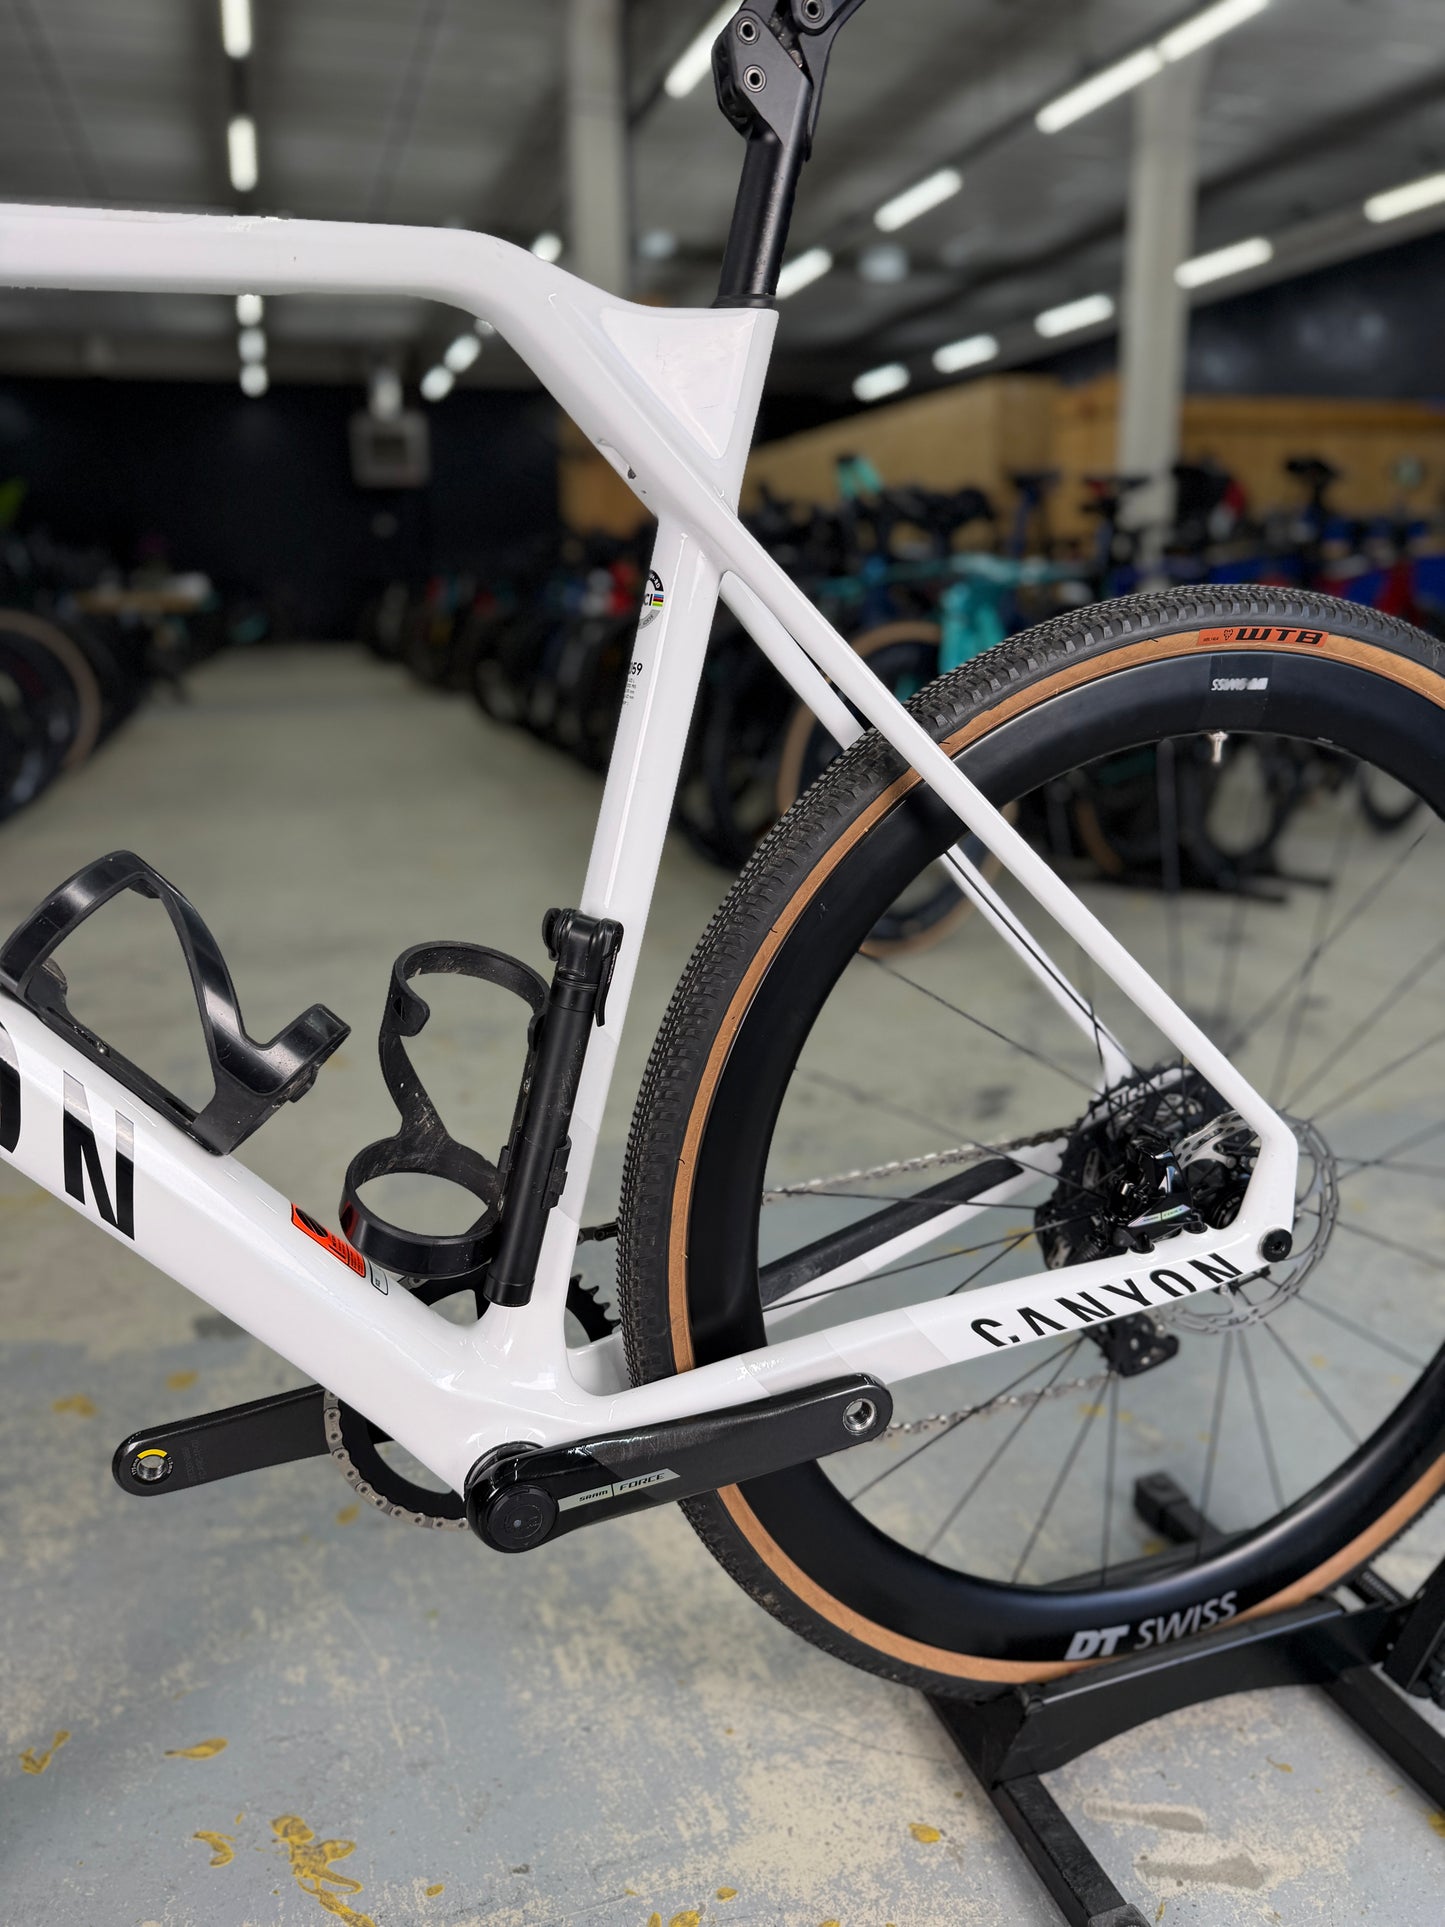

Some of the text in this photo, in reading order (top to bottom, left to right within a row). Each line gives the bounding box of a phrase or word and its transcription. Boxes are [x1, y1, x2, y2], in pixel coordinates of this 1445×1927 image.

[1235, 628, 1324, 645] WTB
[630, 661, 643, 676] 59
[970, 1252, 1244, 1348] CANYON
[579, 1472, 666, 1502] SRAM FORCE
[1064, 1590, 1238, 1661] DT SWISS
